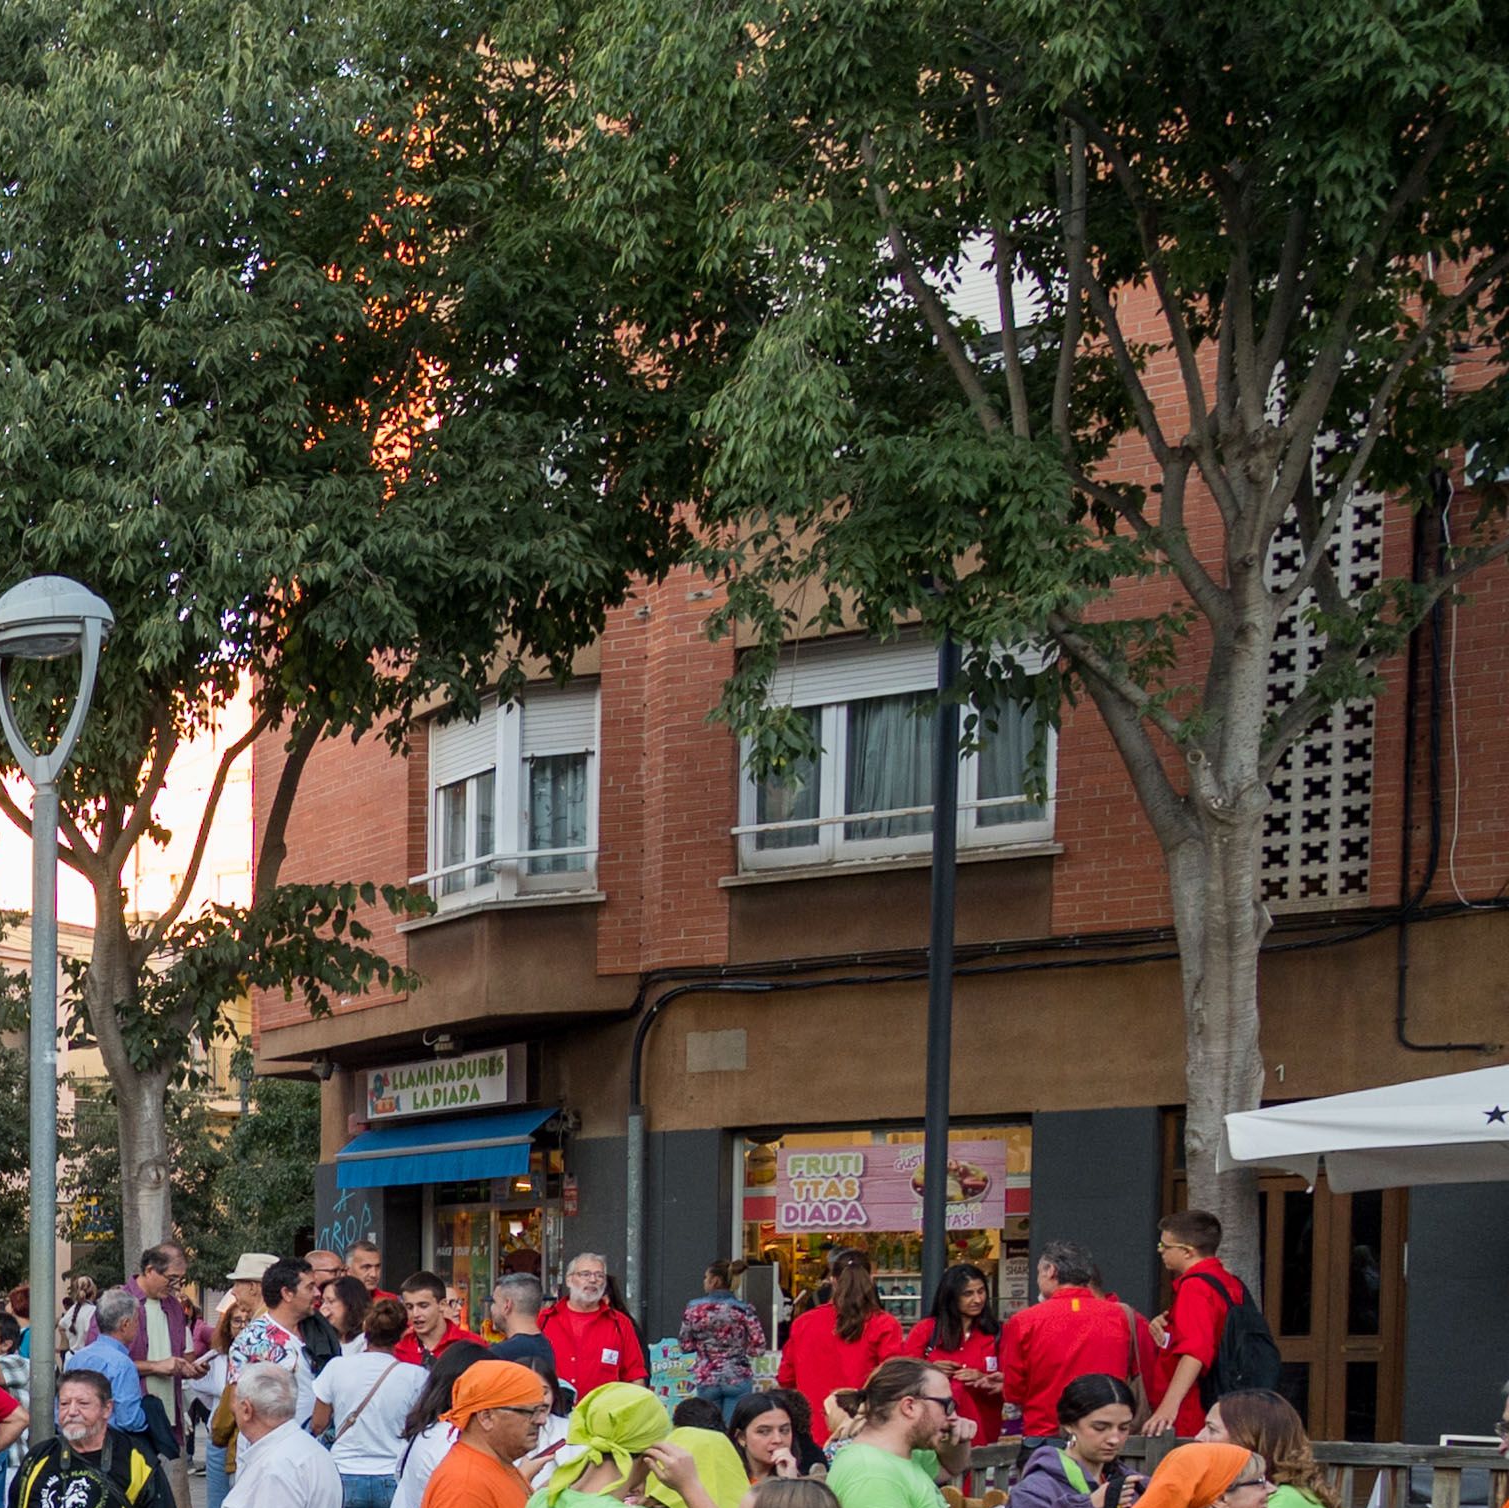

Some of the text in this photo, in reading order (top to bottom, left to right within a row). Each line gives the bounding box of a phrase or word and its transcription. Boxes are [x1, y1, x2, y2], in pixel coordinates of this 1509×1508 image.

[392, 1055, 505, 1091] LLAMINADURES
[1274, 1064, 1286, 1083] 1
[413, 1083, 481, 1110] LA DIADA
[788, 1153, 863, 1178] FRUTI
[895, 1155, 924, 1170] GUST
[791, 1178, 860, 1200] TTAS
[782, 1202, 868, 1226] DIADA
[471, 1247, 489, 1257] PLY
